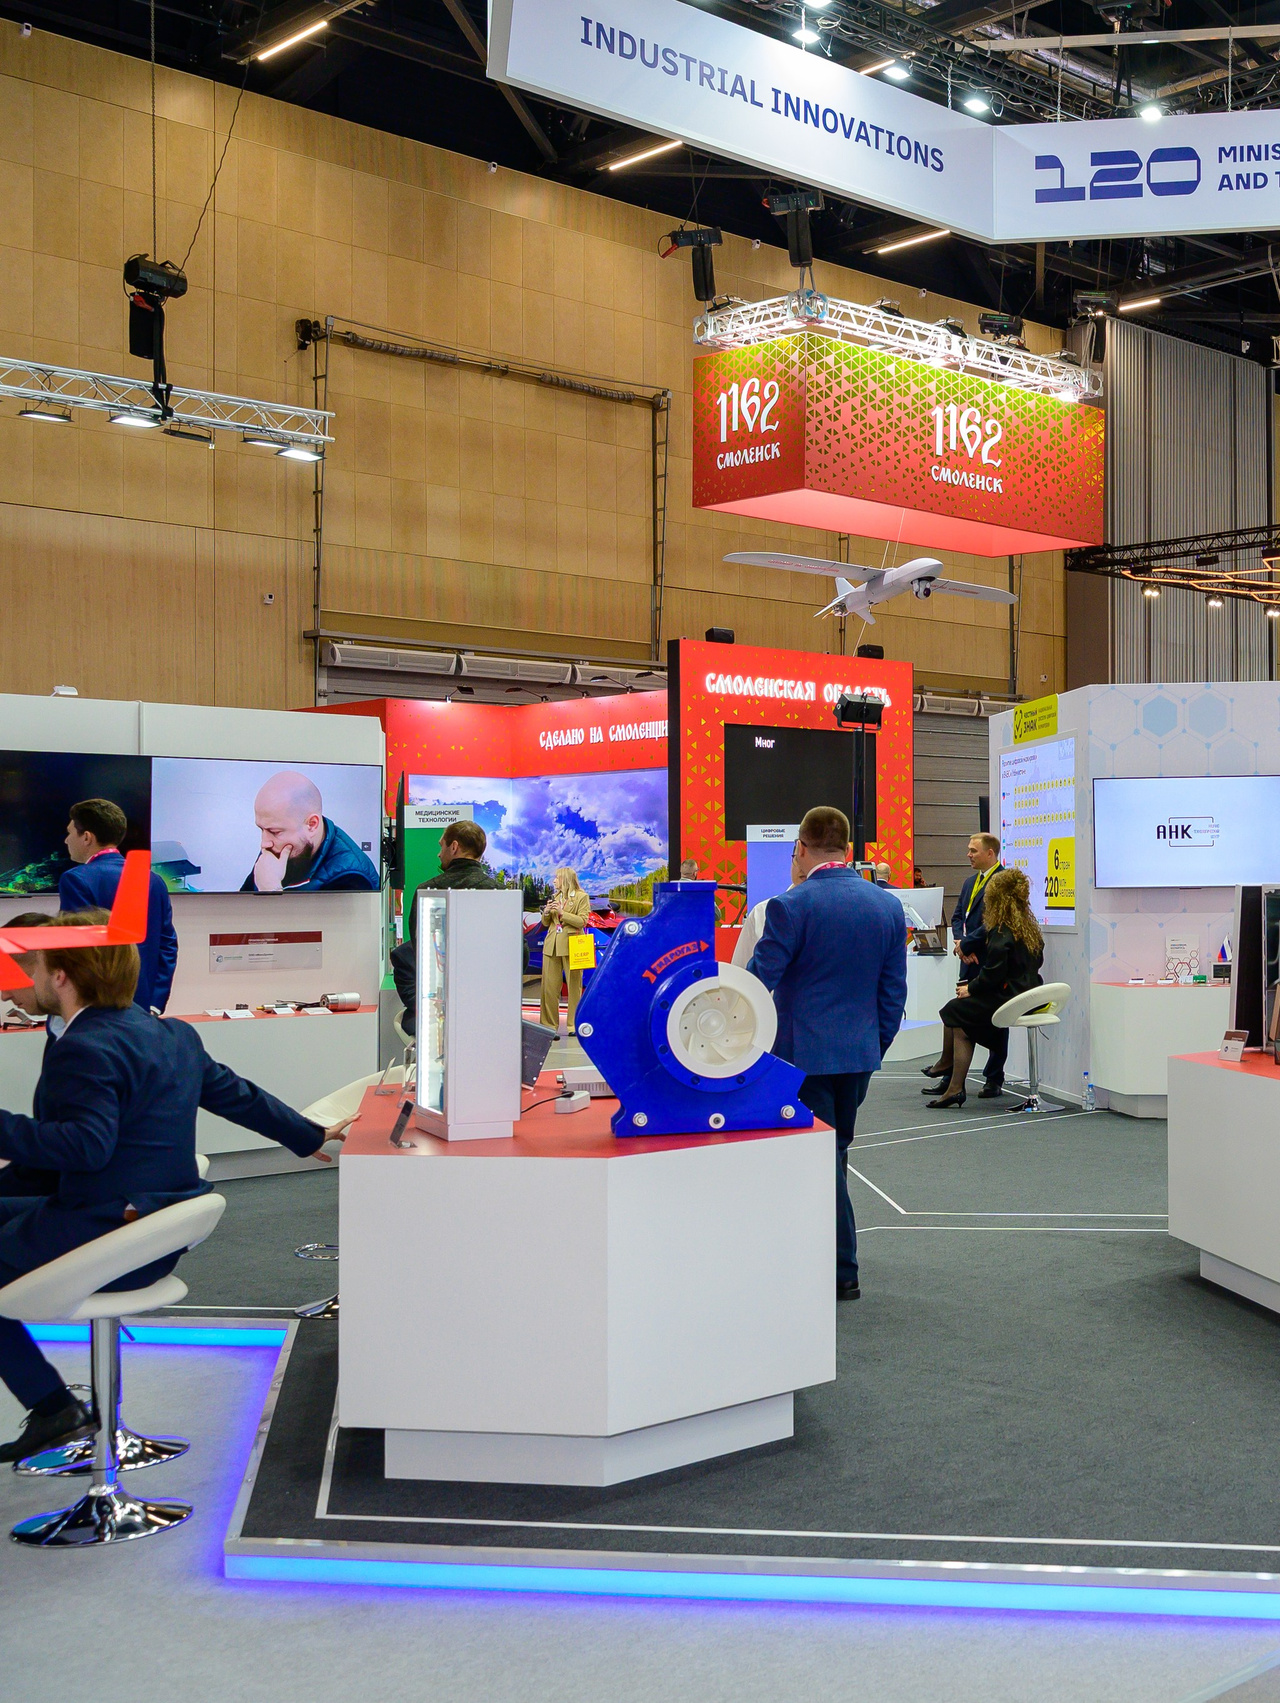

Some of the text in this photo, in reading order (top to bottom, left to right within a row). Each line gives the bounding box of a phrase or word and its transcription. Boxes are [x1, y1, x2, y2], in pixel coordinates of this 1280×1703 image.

[580, 16, 944, 173] INDUSTRIAL INNOVATIONS
[1035, 146, 1201, 203] 120
[1218, 171, 1268, 191] AND
[716, 377, 781, 443] 1162
[931, 402, 1003, 467] 1162
[716, 441, 781, 471] СМОЛЕНСК
[931, 464, 1004, 494] СМОЛЕНСК
[706, 673, 817, 701] СМОЛЕНСКАЯ
[539, 728, 584, 750] СДЕЛАНО
[590, 726, 603, 743] НА
[755, 737, 775, 748] Мног
[1054, 849, 1059, 870] 6
[1044, 876, 1059, 897] 220
[653, 943, 698, 972] ГИДРОГАЗ
